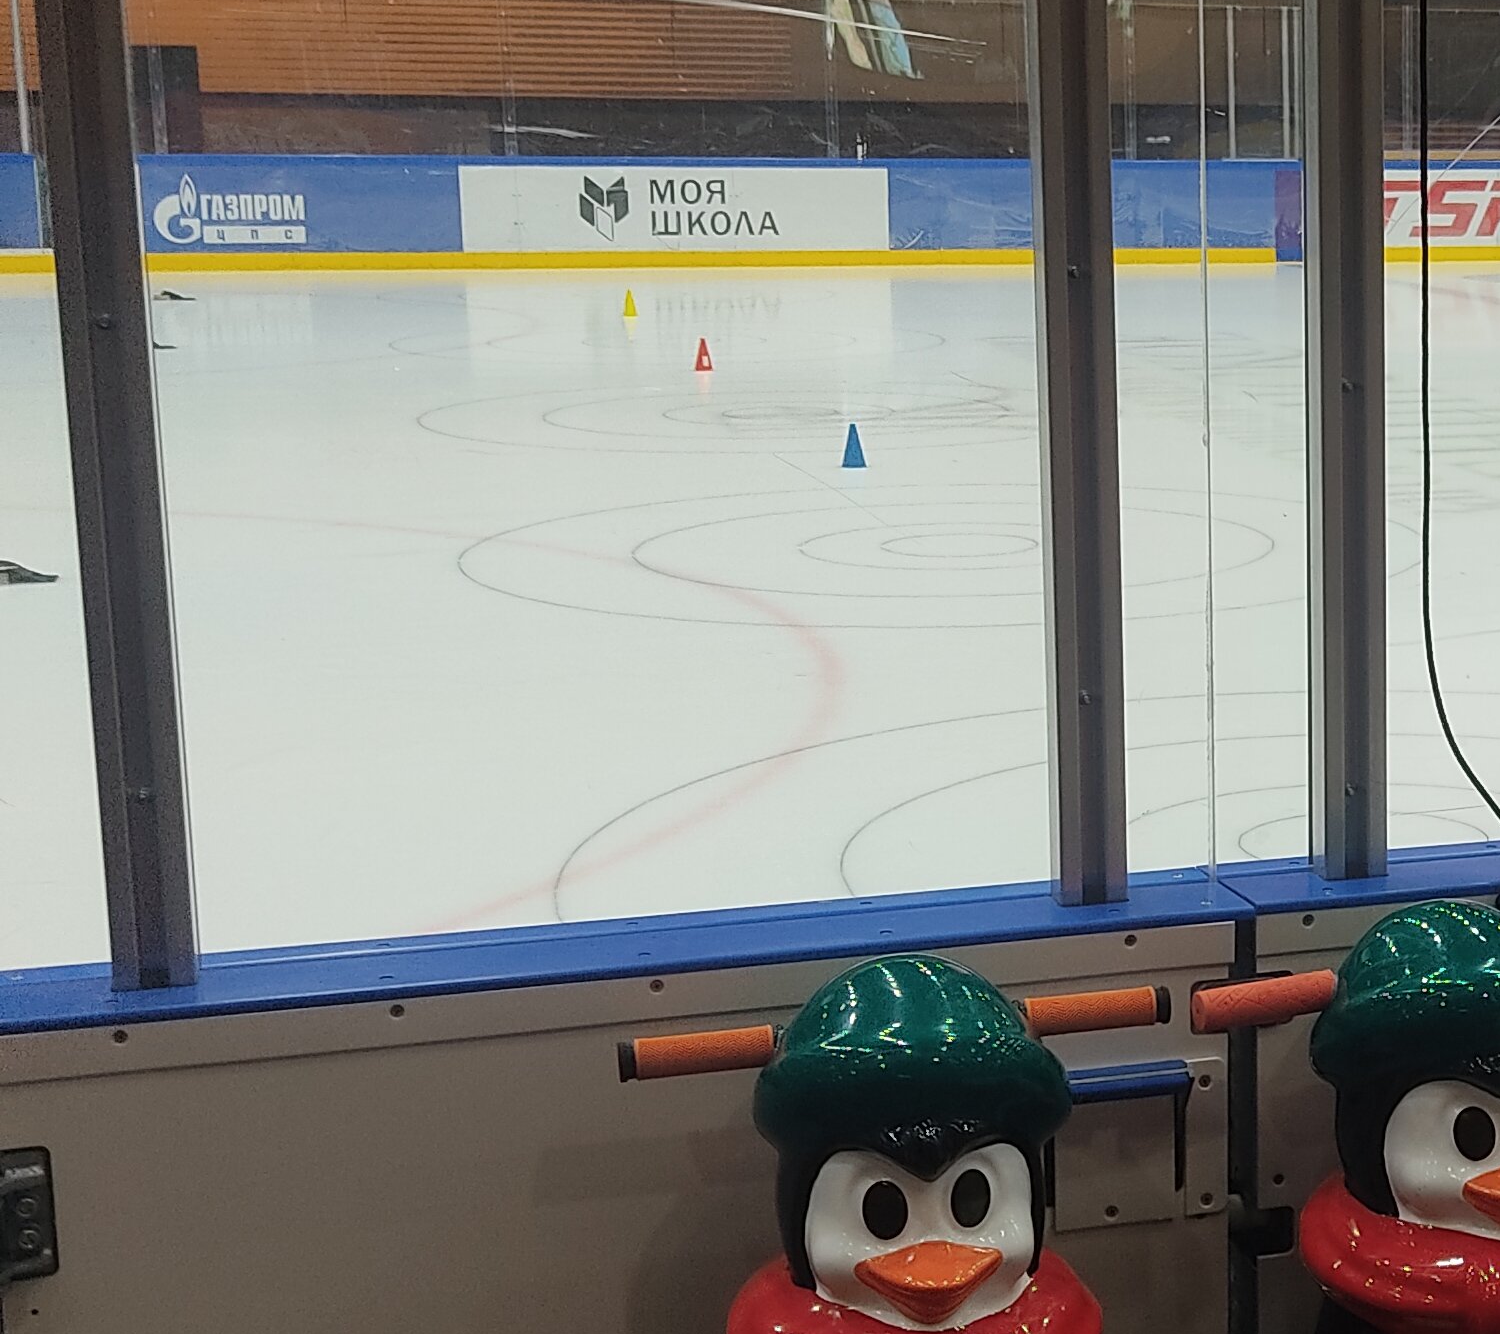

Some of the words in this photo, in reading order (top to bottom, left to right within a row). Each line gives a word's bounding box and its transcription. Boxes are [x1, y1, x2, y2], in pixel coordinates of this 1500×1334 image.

[650, 179, 726, 204] МОЯ
[200, 194, 306, 221] ГАЗПРОМ
[651, 210, 780, 236] ШКОЛА
